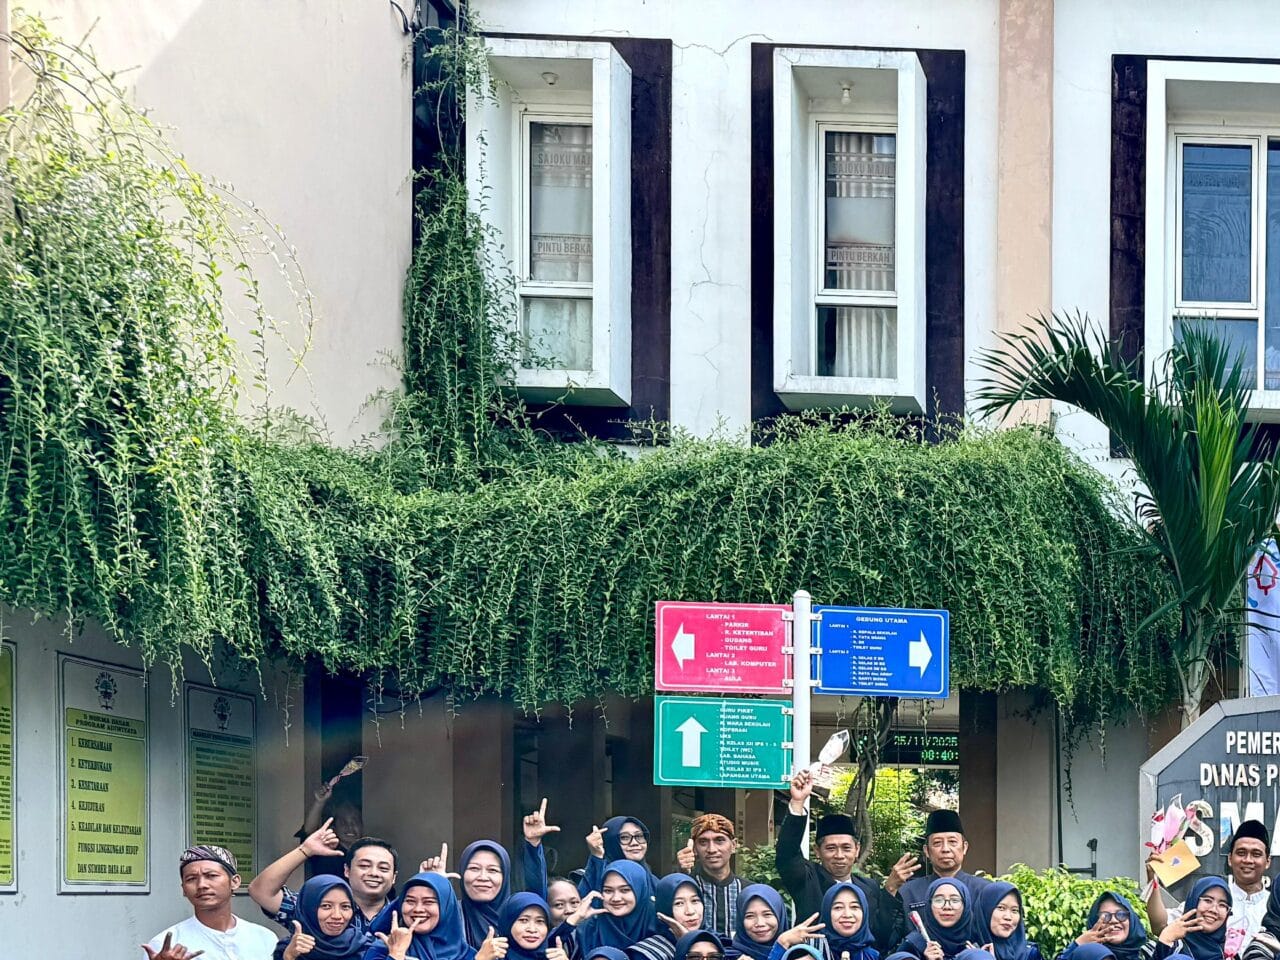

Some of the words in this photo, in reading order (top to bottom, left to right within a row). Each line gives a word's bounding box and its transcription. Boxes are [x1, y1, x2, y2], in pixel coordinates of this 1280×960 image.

[537, 242, 561, 253] PINTU
[564, 242, 591, 253] BERKA
[831, 250, 855, 261] PINTU
[857, 251, 890, 263] BERKAH
[75, 719, 106, 729] PROGRAM
[894, 735, 958, 746] 25/11/2025
[71, 758, 76, 767] 2.
[1200, 763, 1260, 787] DINAS
[71, 779, 76, 789] 3.
[71, 800, 76, 810] 4.
[71, 821, 76, 831] 5.
[78, 822, 102, 833] KEADILAN
[102, 824, 112, 833] DAN
[78, 842, 95, 853] FUNGSI
[96, 843, 124, 854] LINGKUNGAN
[125, 845, 139, 855] HIDUP
[77, 863, 87, 873] DAN
[87, 864, 107, 874] SUMBER
